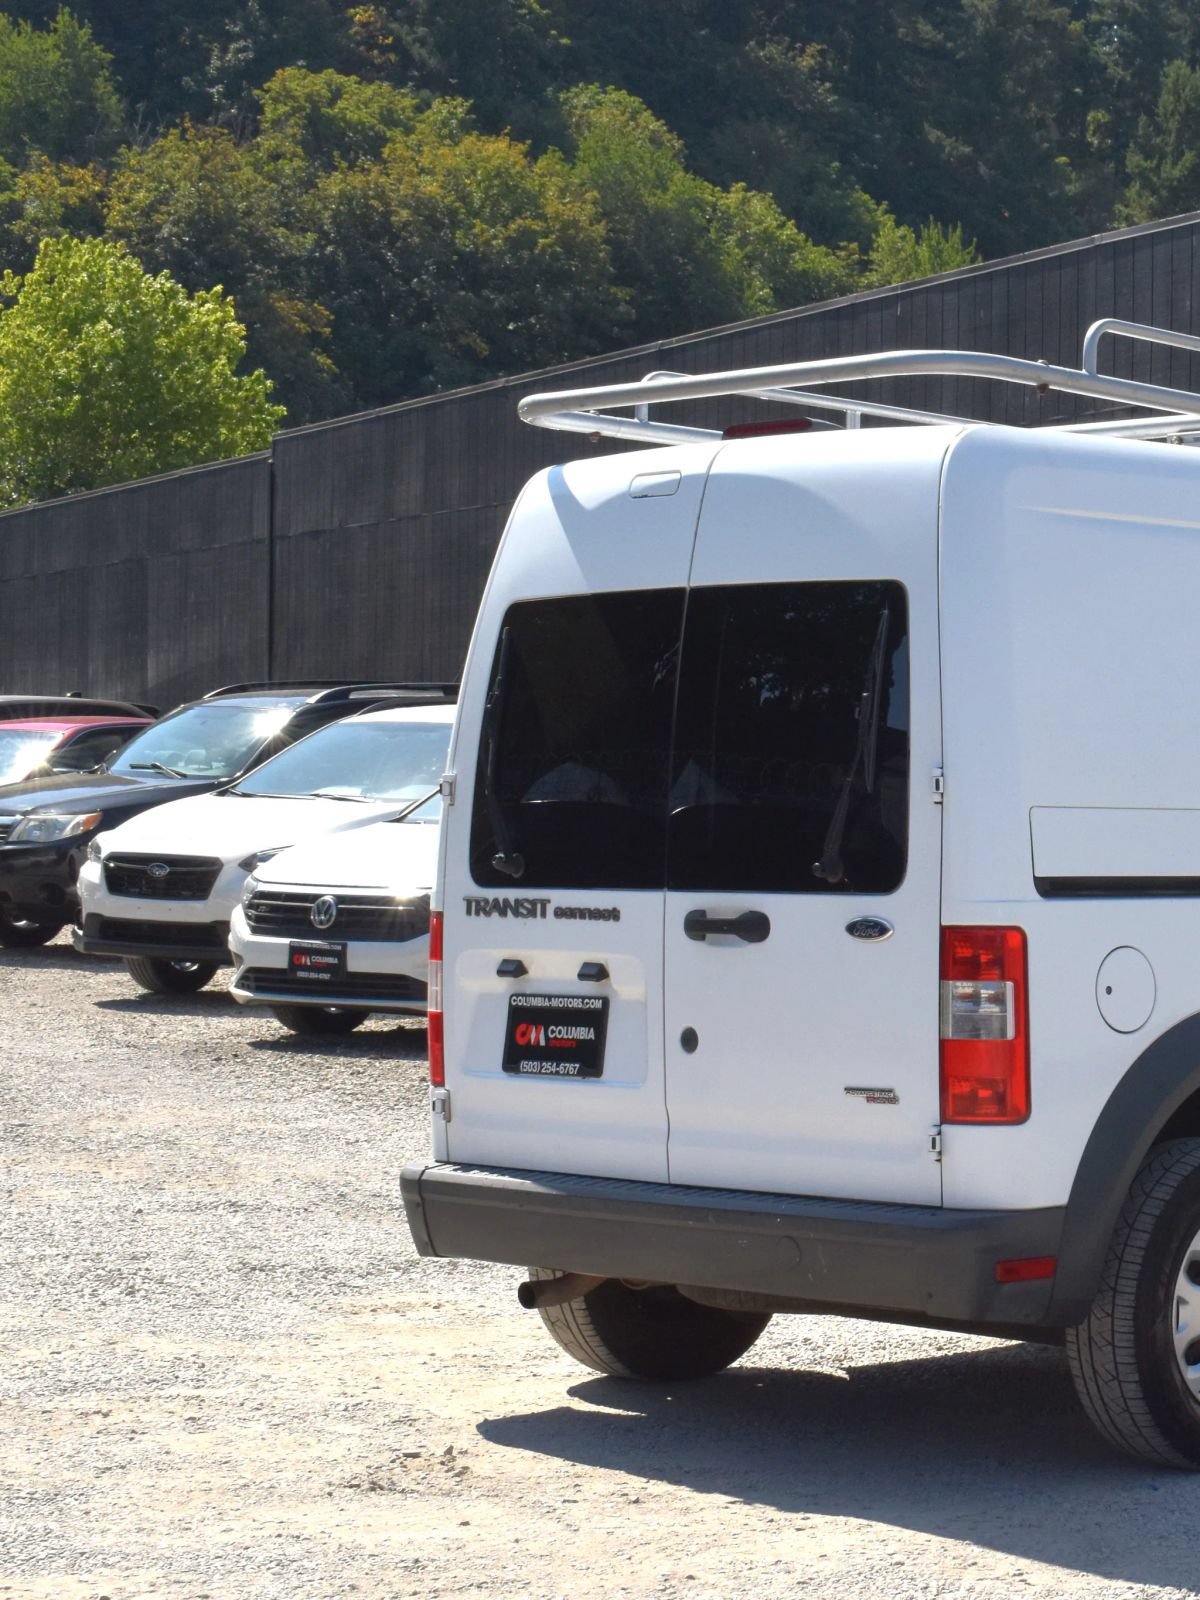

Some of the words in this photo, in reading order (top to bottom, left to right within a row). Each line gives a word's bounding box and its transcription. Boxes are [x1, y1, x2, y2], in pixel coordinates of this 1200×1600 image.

[463, 896, 551, 919] TRANSIT
[553, 906, 621, 922] connect
[511, 996, 603, 1009] COLUMBIA-MOTORS.COM
[548, 1025, 595, 1040] COLUMBIA
[520, 1061, 541, 1073] (503)
[541, 1062, 580, 1075] 254-6767
